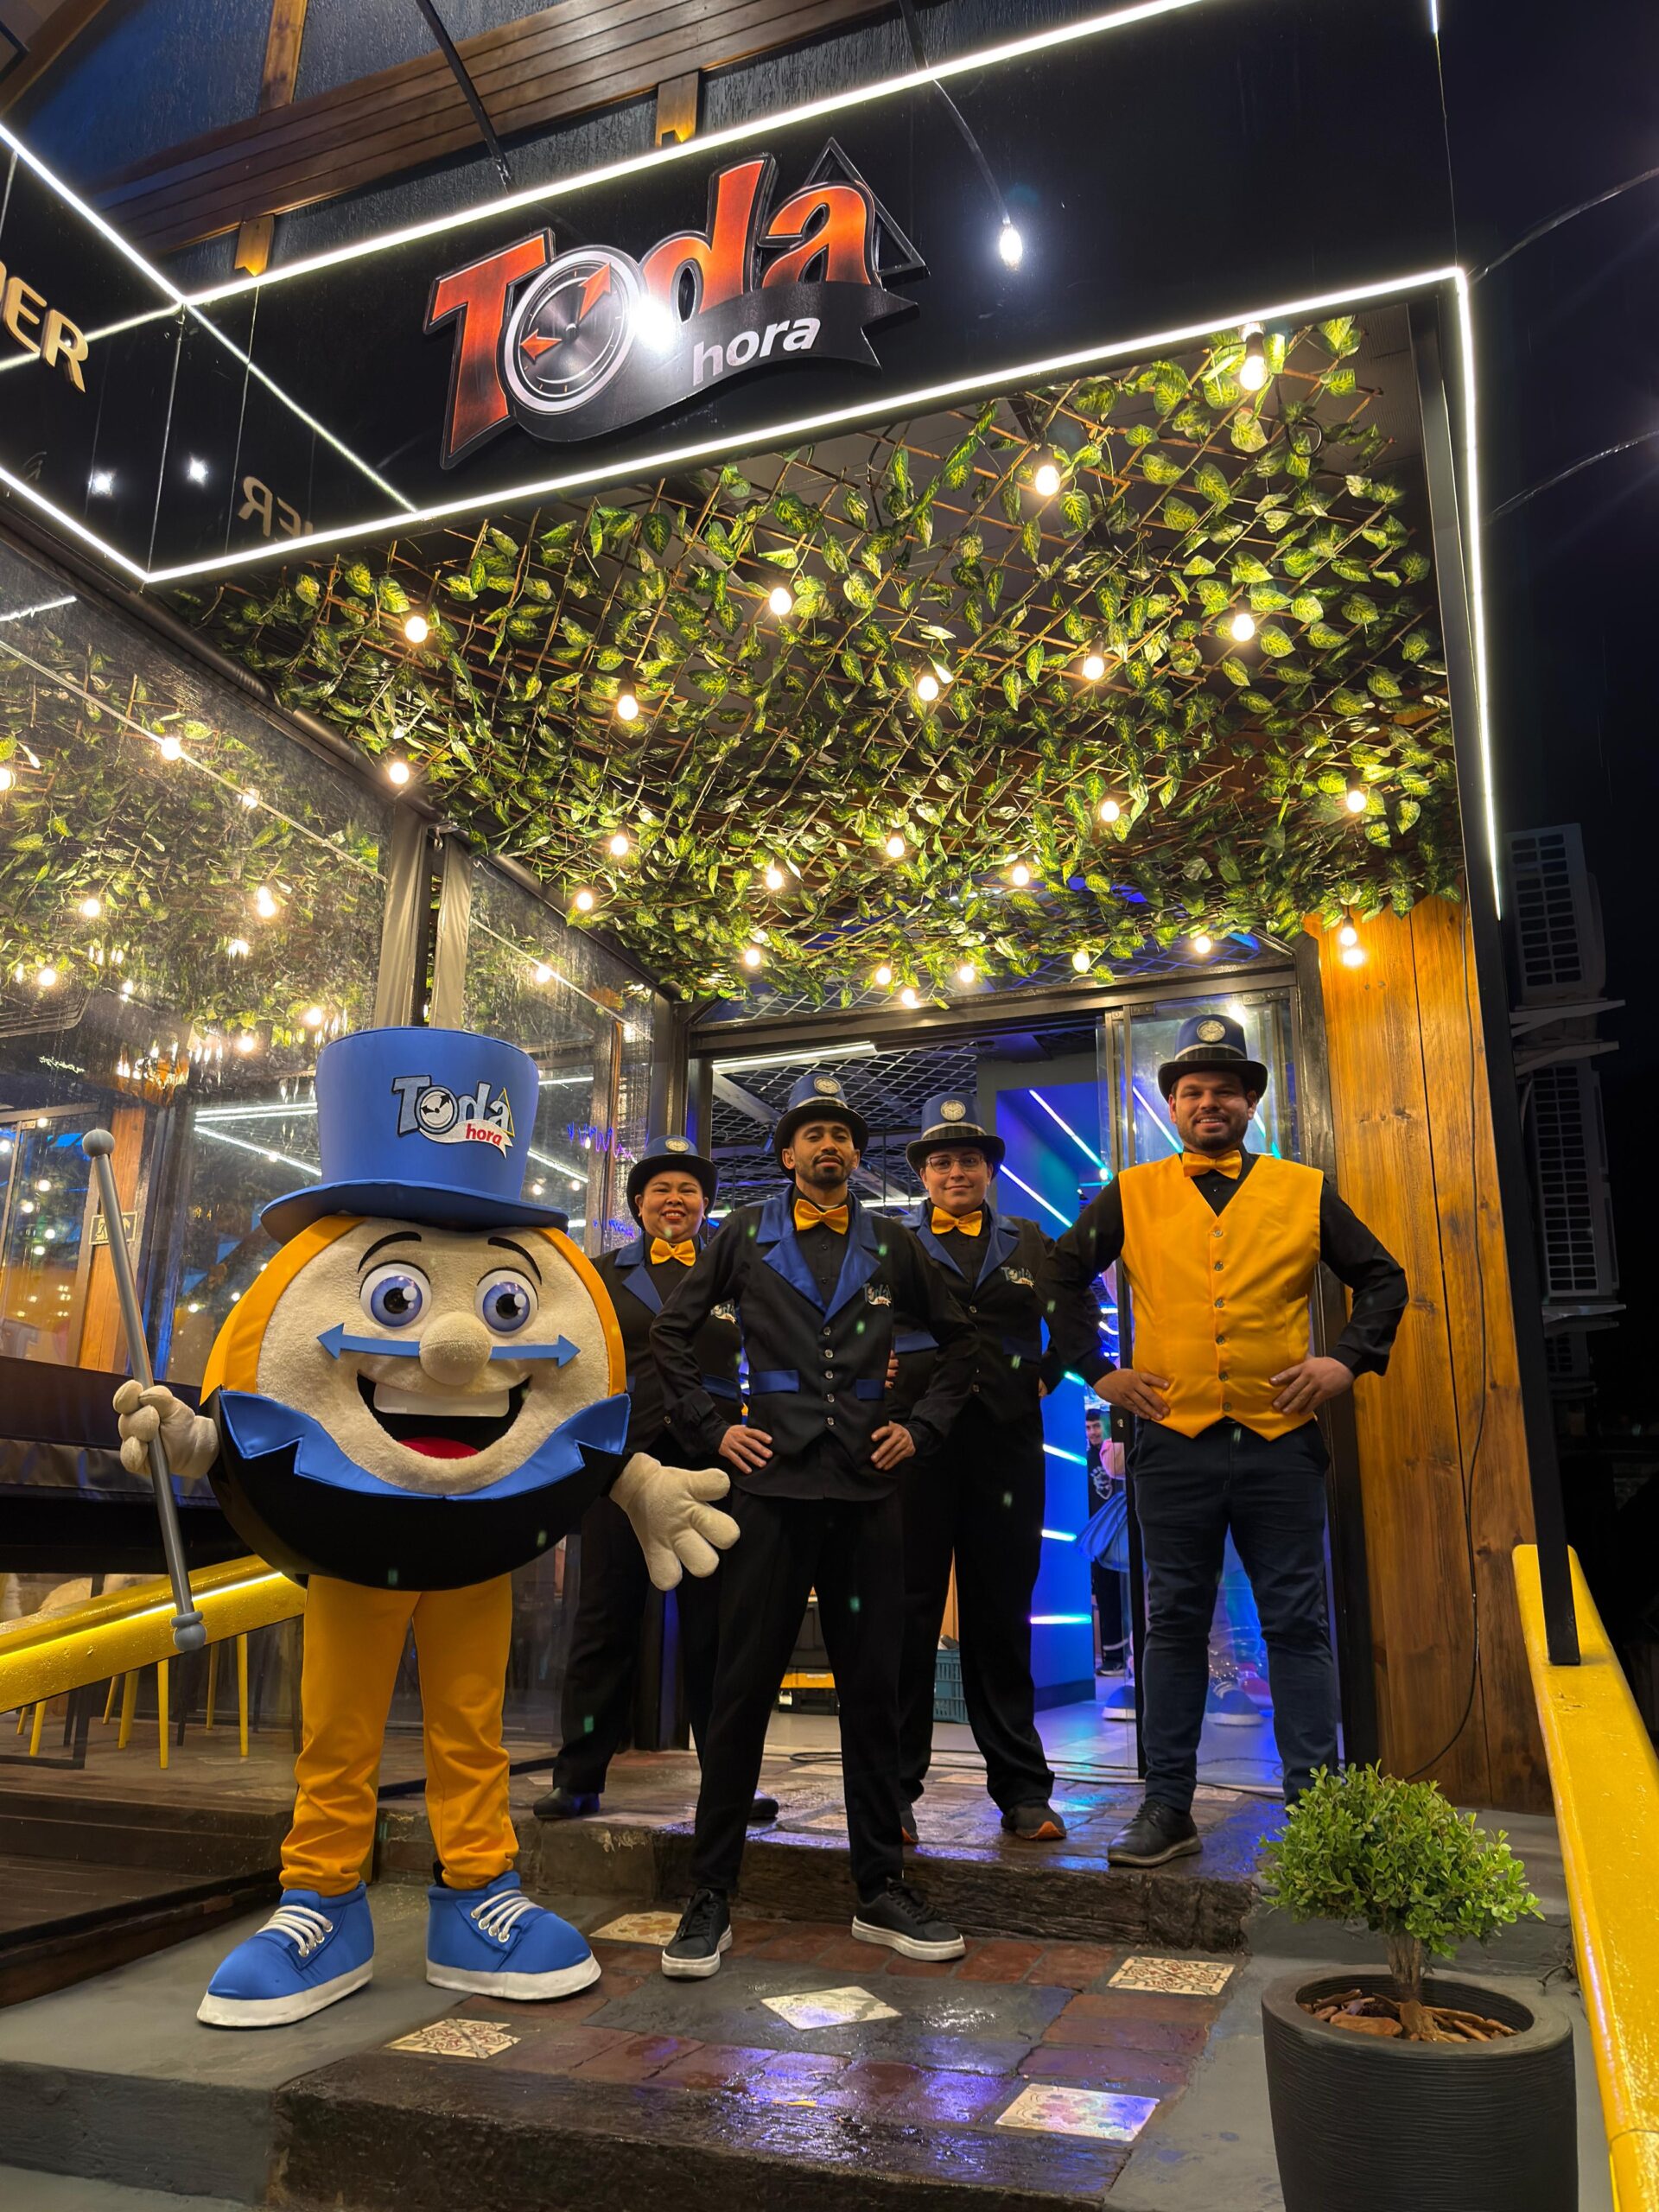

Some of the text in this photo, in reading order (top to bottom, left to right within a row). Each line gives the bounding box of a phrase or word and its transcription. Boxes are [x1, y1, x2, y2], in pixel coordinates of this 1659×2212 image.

[0, 261, 89, 393] ER
[692, 316, 822, 387] hora
[465, 1122, 503, 1147] hora
